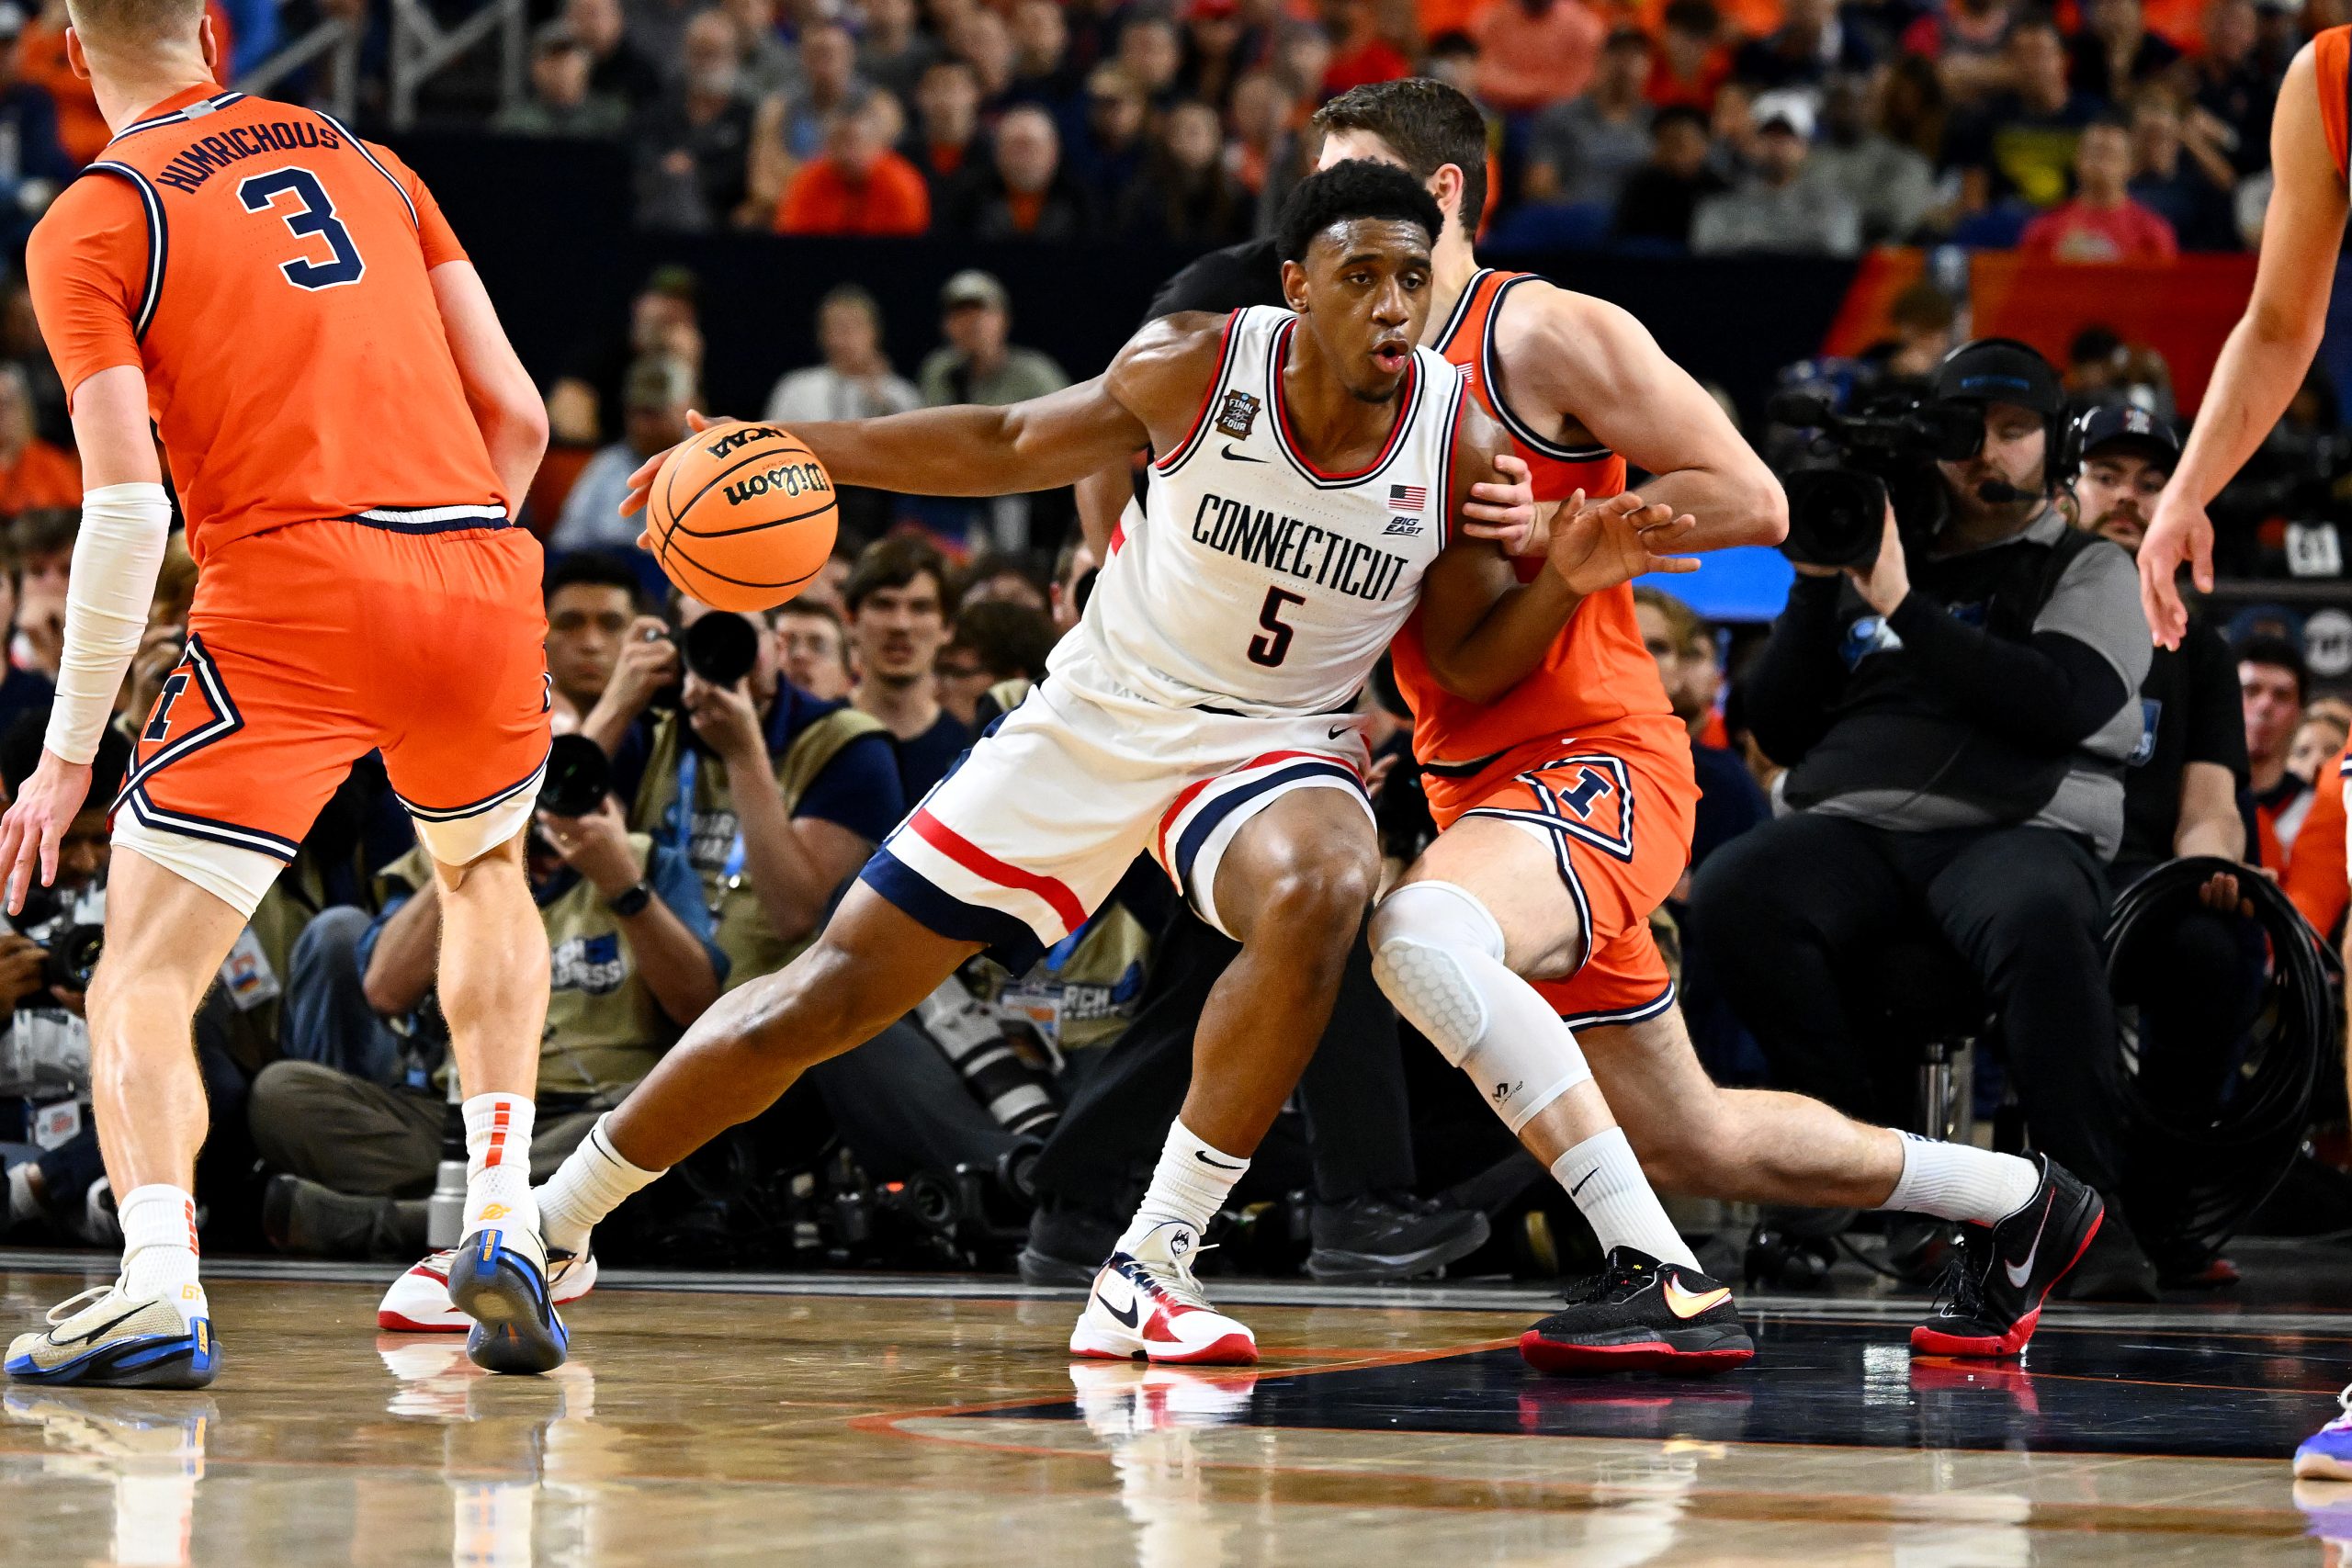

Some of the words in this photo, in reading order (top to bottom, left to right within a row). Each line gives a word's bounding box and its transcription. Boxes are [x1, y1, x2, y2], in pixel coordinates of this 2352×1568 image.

[155, 121, 340, 195] HUMRICHOUS
[235, 165, 367, 292] 3
[1222, 416, 1247, 432] FOUR
[1228, 398, 1254, 414] FINAL
[722, 462, 831, 506] Wilson
[1385, 524, 1424, 535] EAST
[1391, 516, 1419, 526] BIG
[1192, 493, 1408, 602] CONNECTICUT
[1247, 585, 1306, 668] 5
[1557, 765, 1614, 822] I
